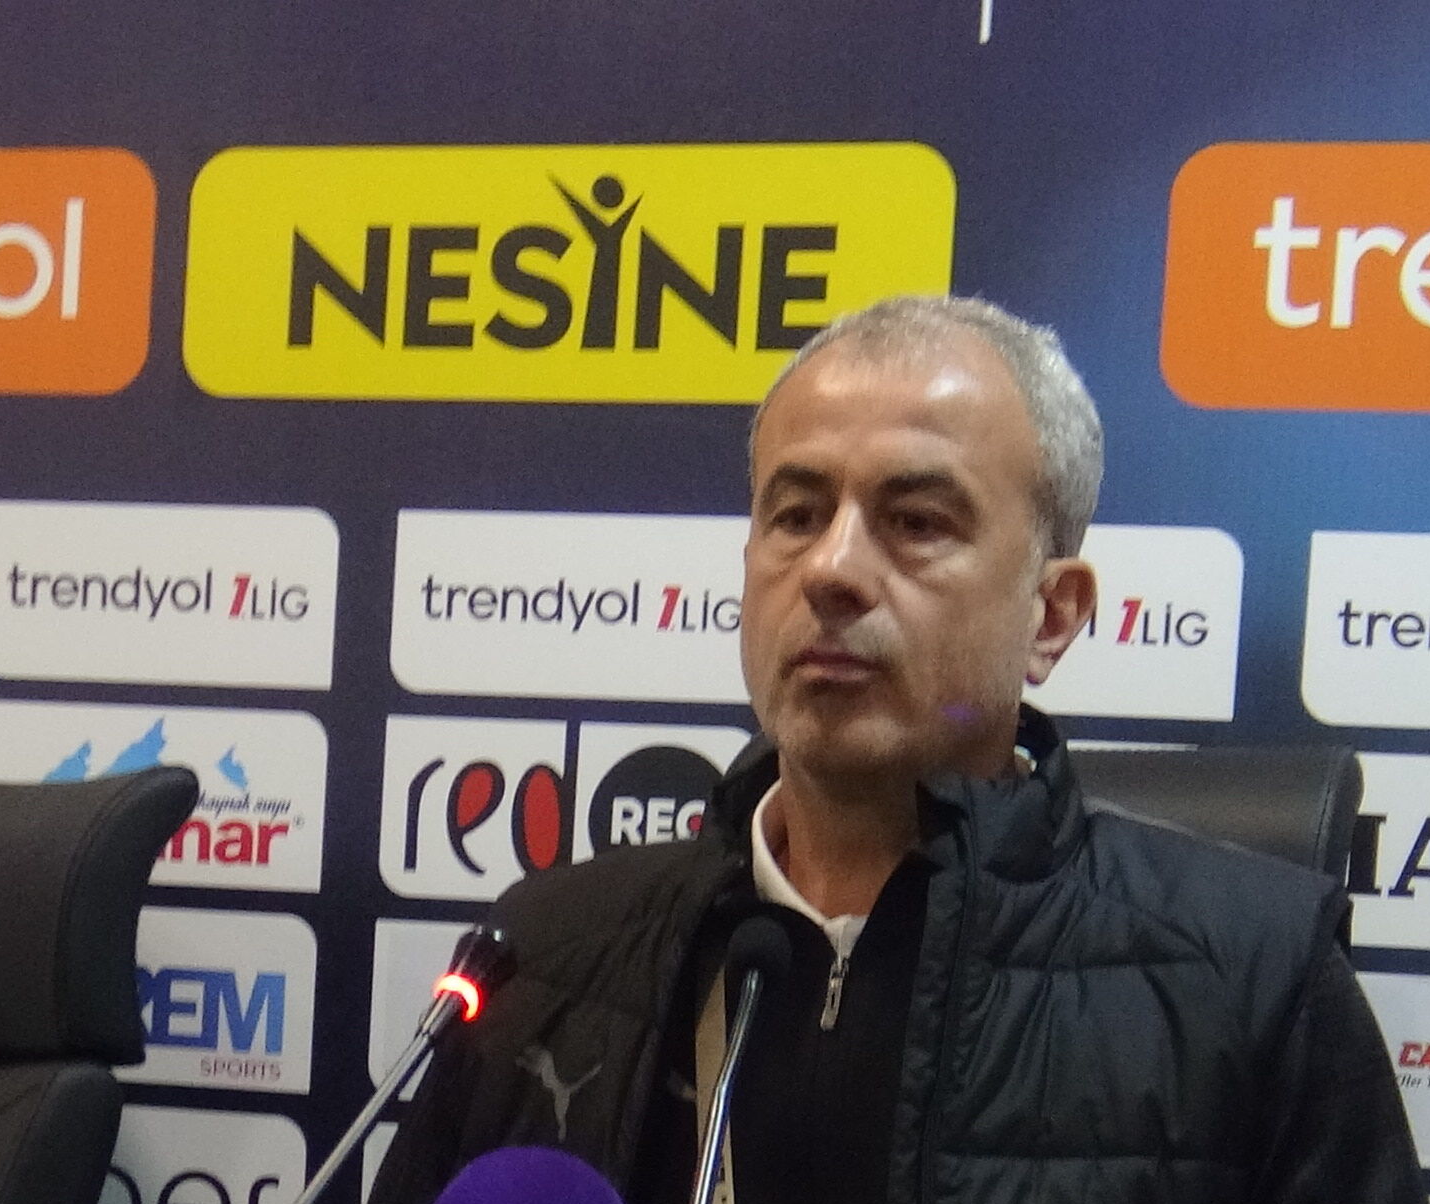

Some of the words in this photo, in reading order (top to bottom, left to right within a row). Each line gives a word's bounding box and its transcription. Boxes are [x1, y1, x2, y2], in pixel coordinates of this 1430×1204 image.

[7, 563, 214, 622] trendyol
[421, 573, 641, 633] trendyol
[155, 818, 290, 866] nar
[199, 1057, 281, 1082] SPORTS
